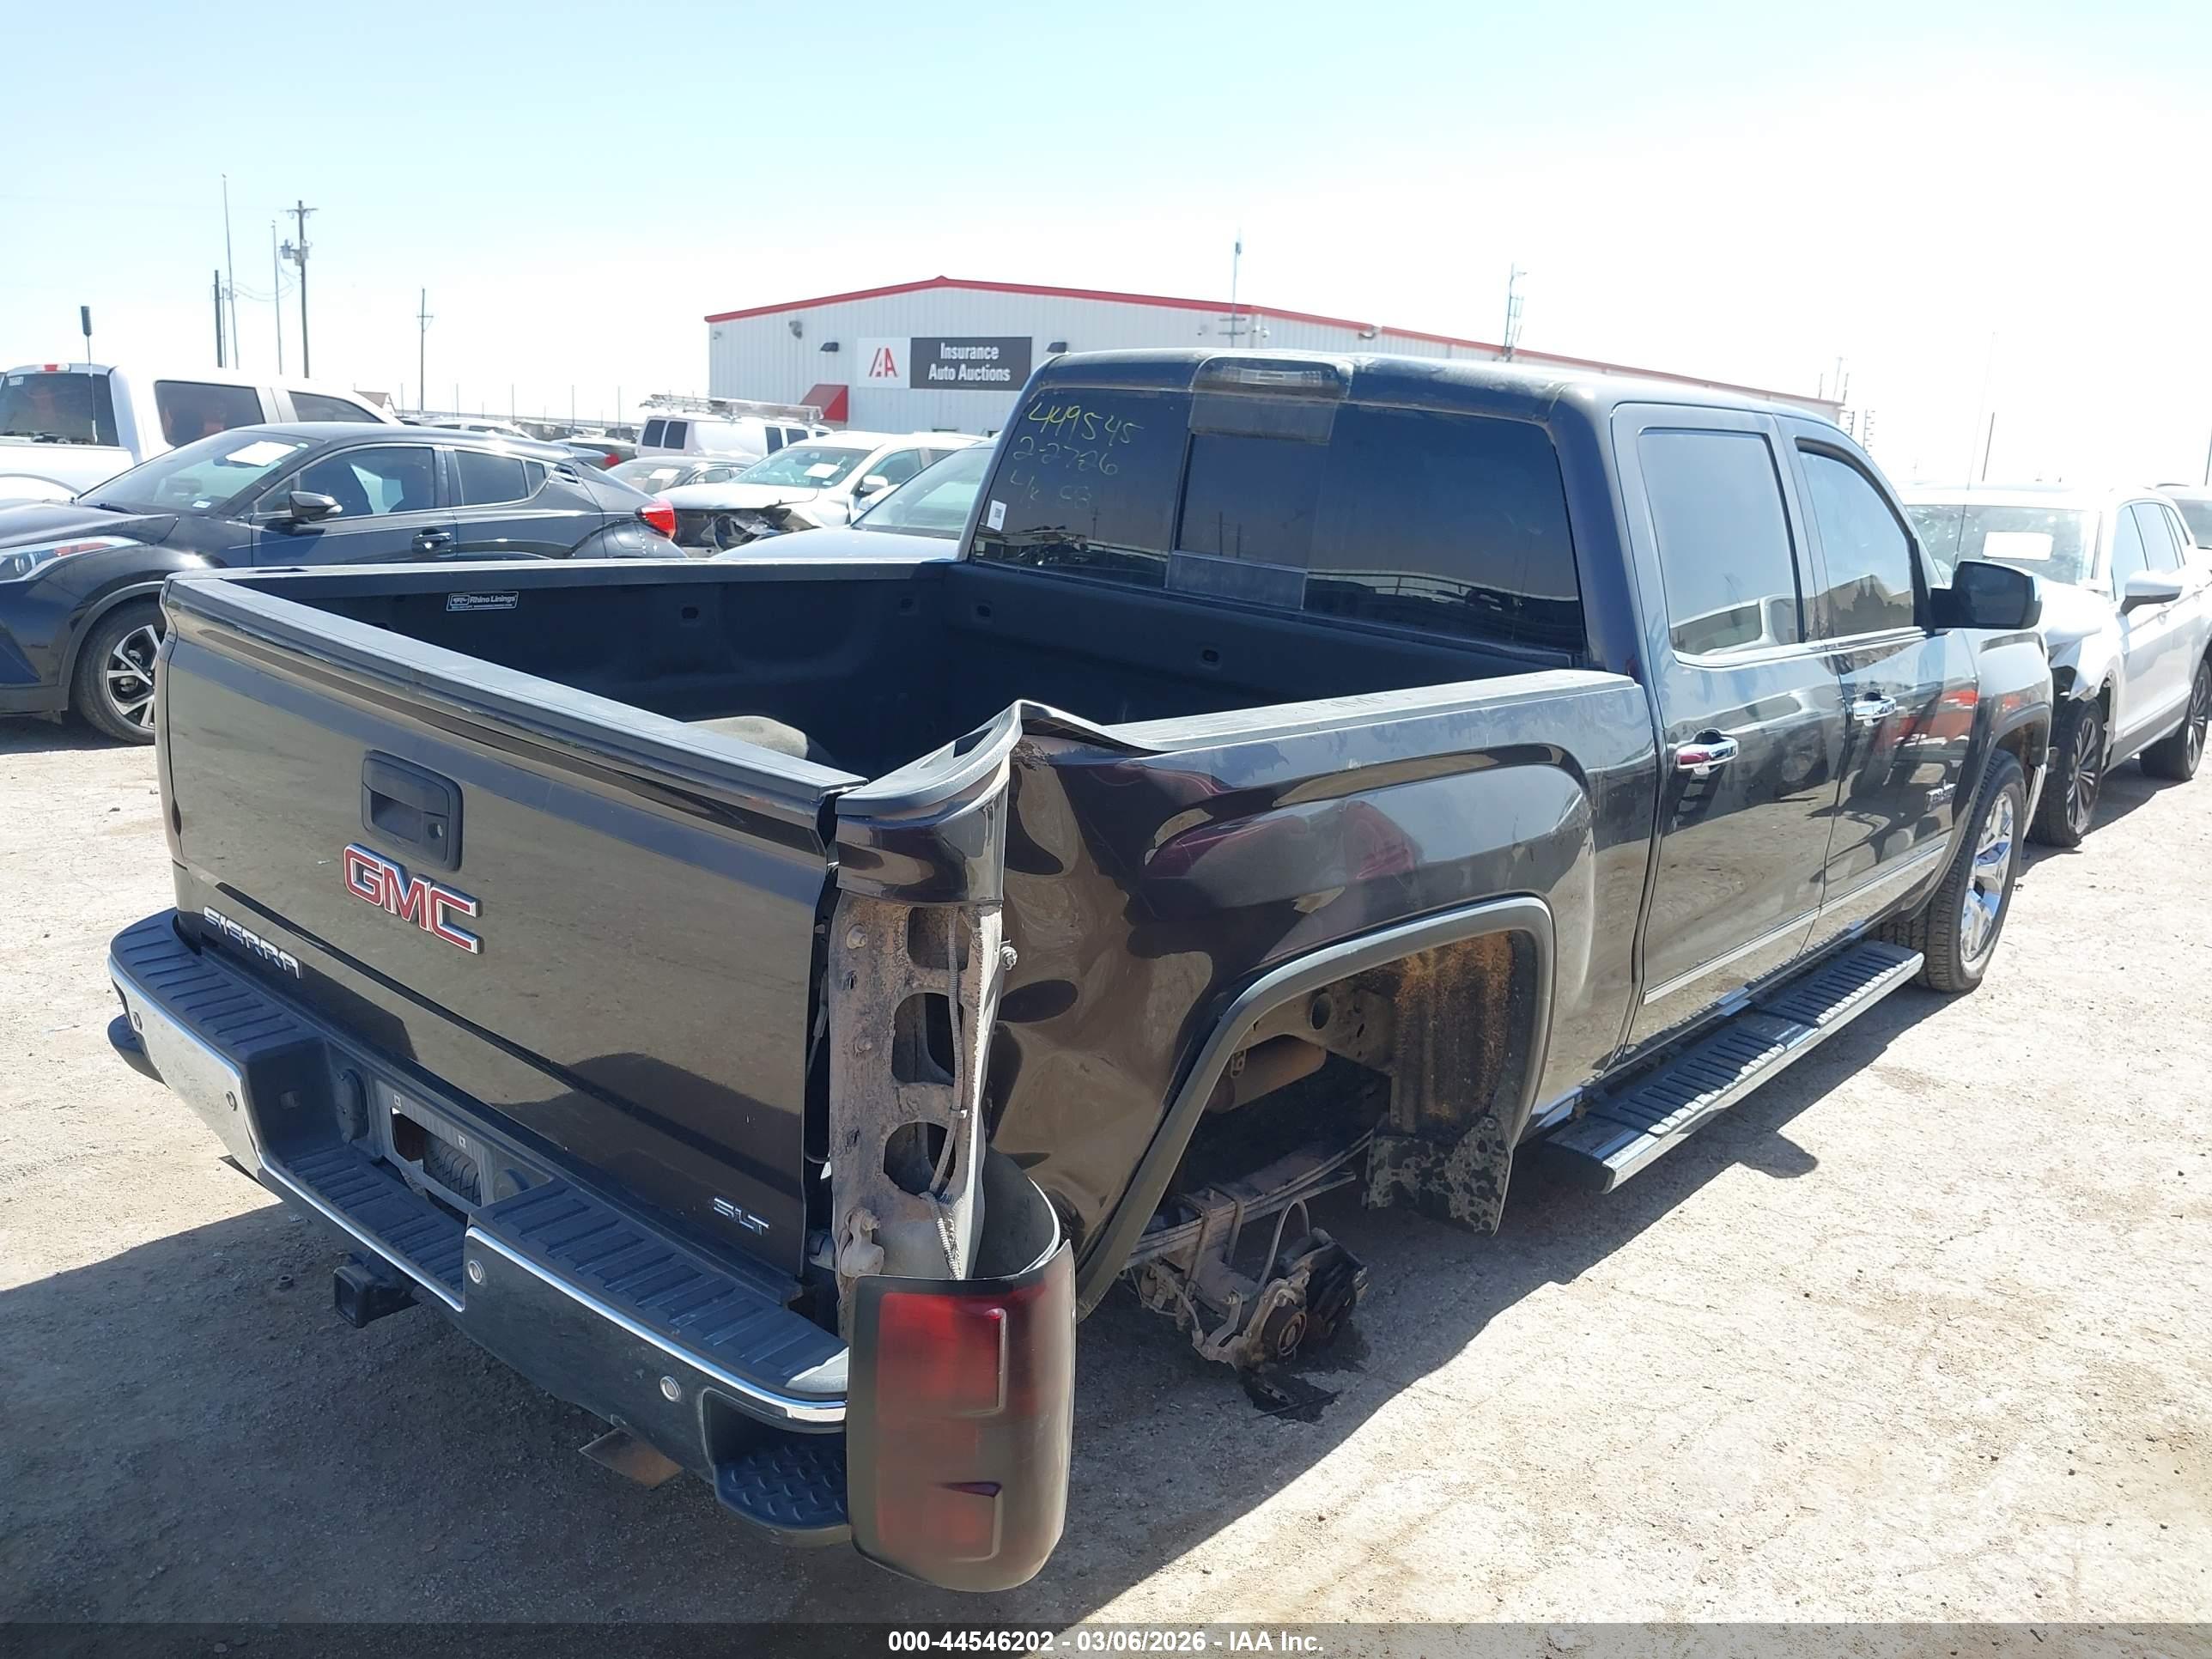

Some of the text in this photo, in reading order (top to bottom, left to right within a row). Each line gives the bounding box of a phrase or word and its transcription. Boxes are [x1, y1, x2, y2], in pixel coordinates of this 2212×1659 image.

[928, 363, 1011, 382] Auto Auctions
[940, 343, 1000, 361] Insurance
[1028, 401, 1145, 447] 449545
[490, 594, 515, 604] Linings
[343, 842, 483, 955] GMC
[203, 905, 301, 980] SIERRA
[714, 1196, 770, 1237] SLT
